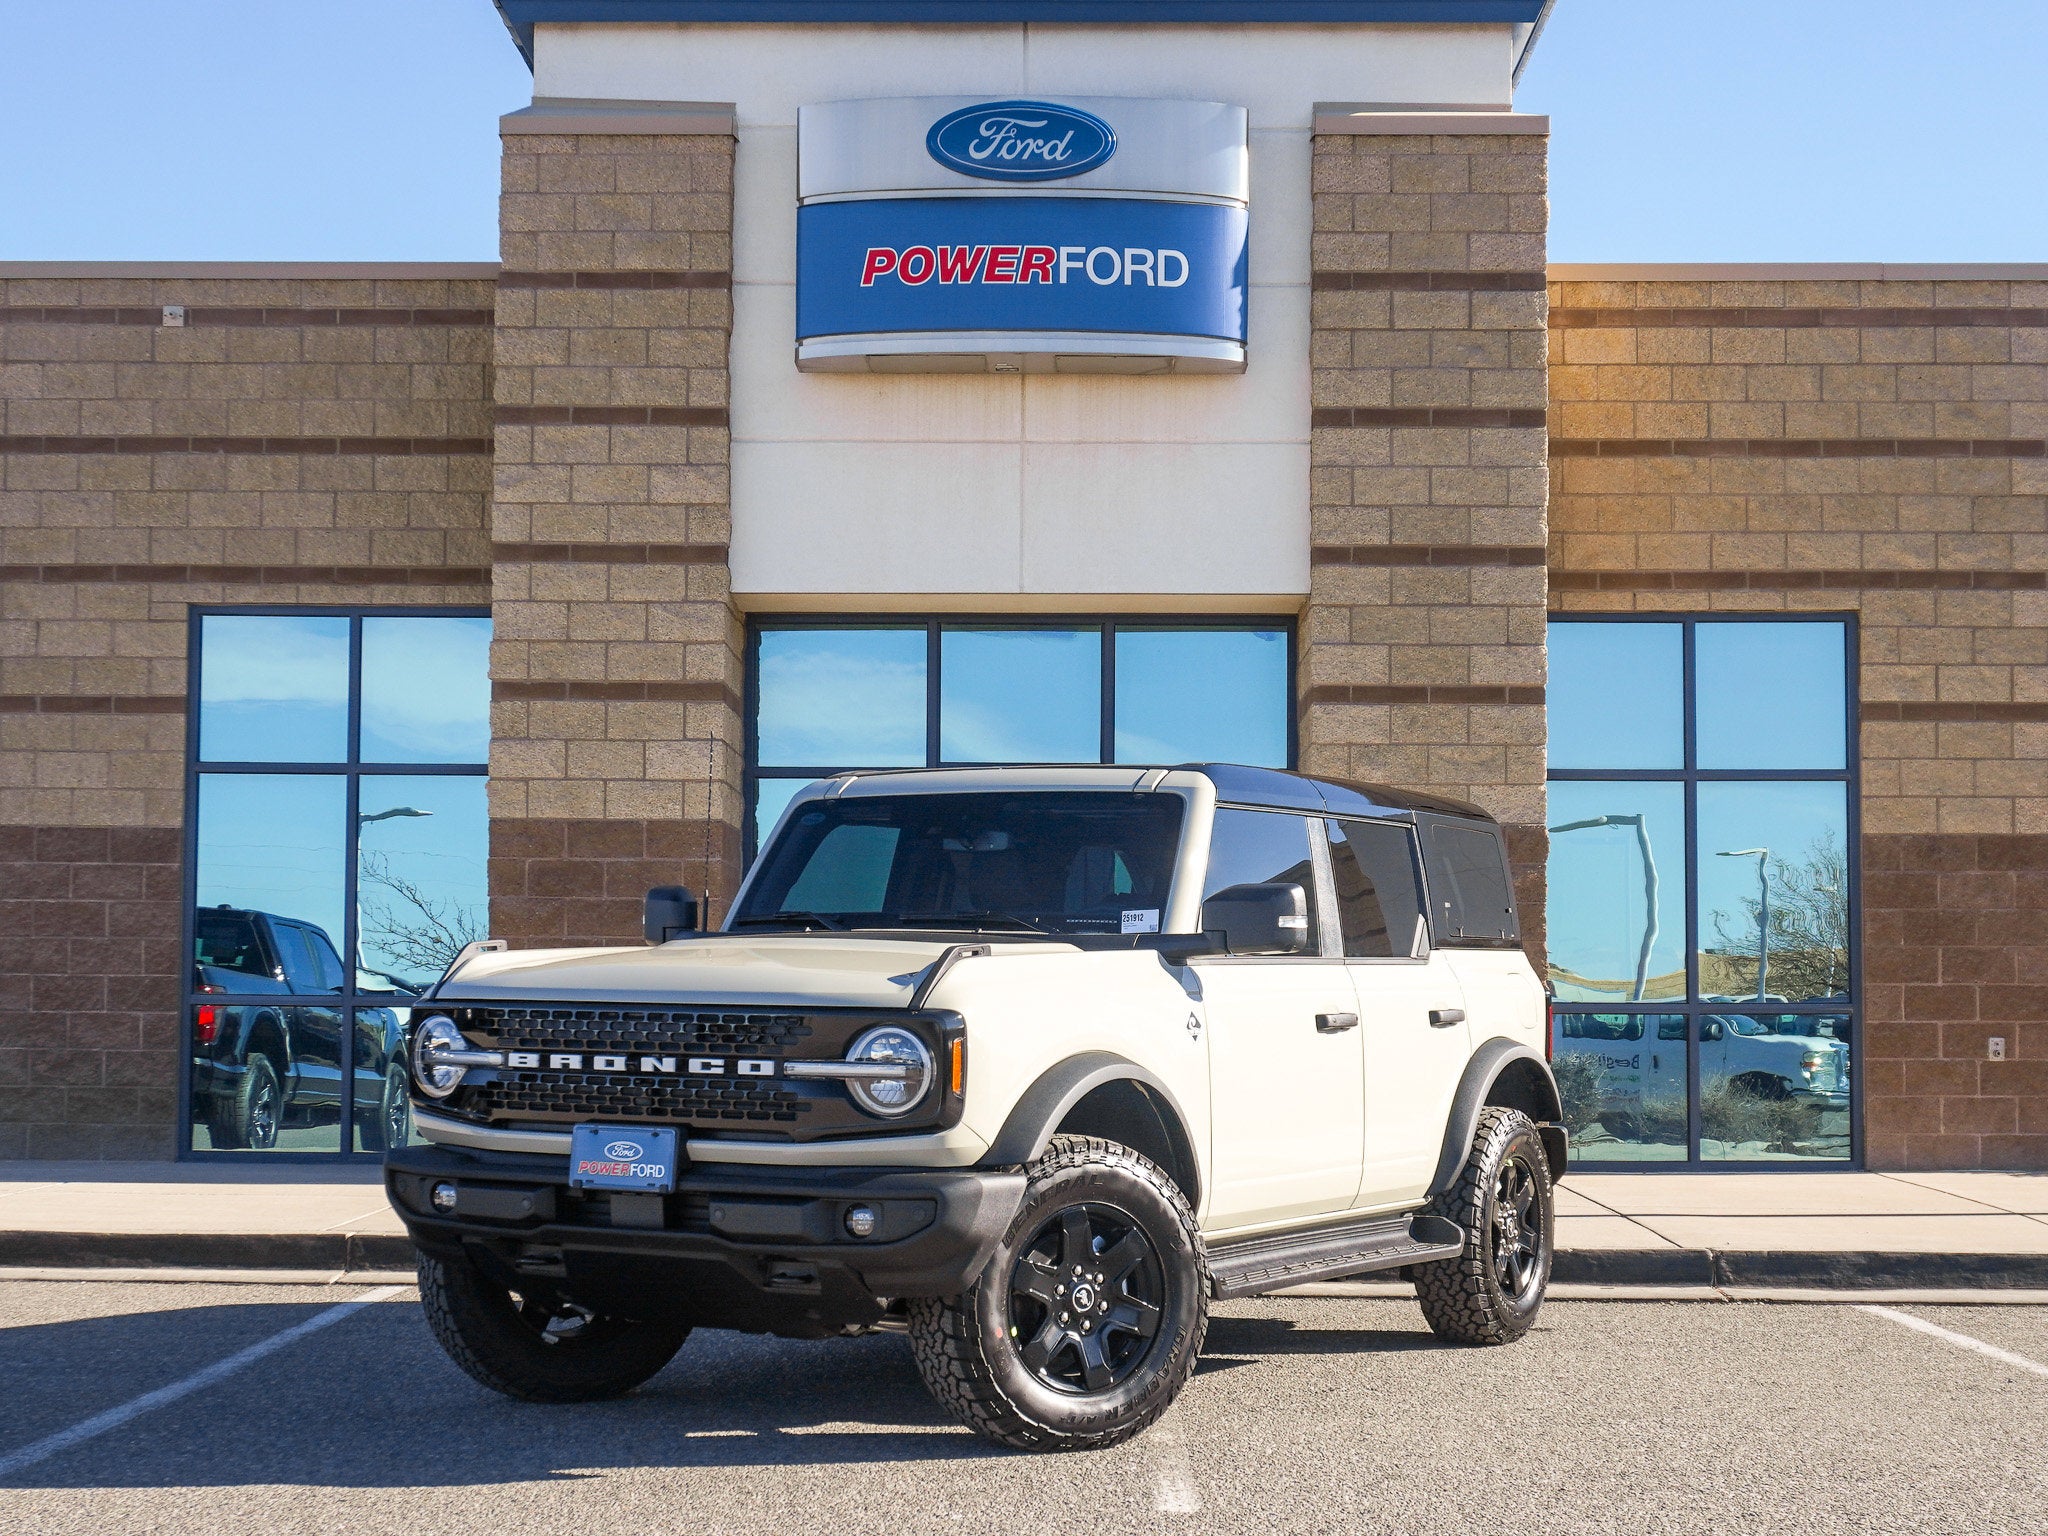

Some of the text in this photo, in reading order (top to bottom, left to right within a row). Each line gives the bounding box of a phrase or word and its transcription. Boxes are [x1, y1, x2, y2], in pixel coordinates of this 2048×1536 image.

[968, 117, 1075, 161] Ford
[860, 245, 1190, 288] POWERFORD
[1122, 913, 1144, 923] 251912
[507, 1052, 775, 1076] BRONCO
[612, 1145, 636, 1157] Ford
[578, 1160, 665, 1178] POWERFORD
